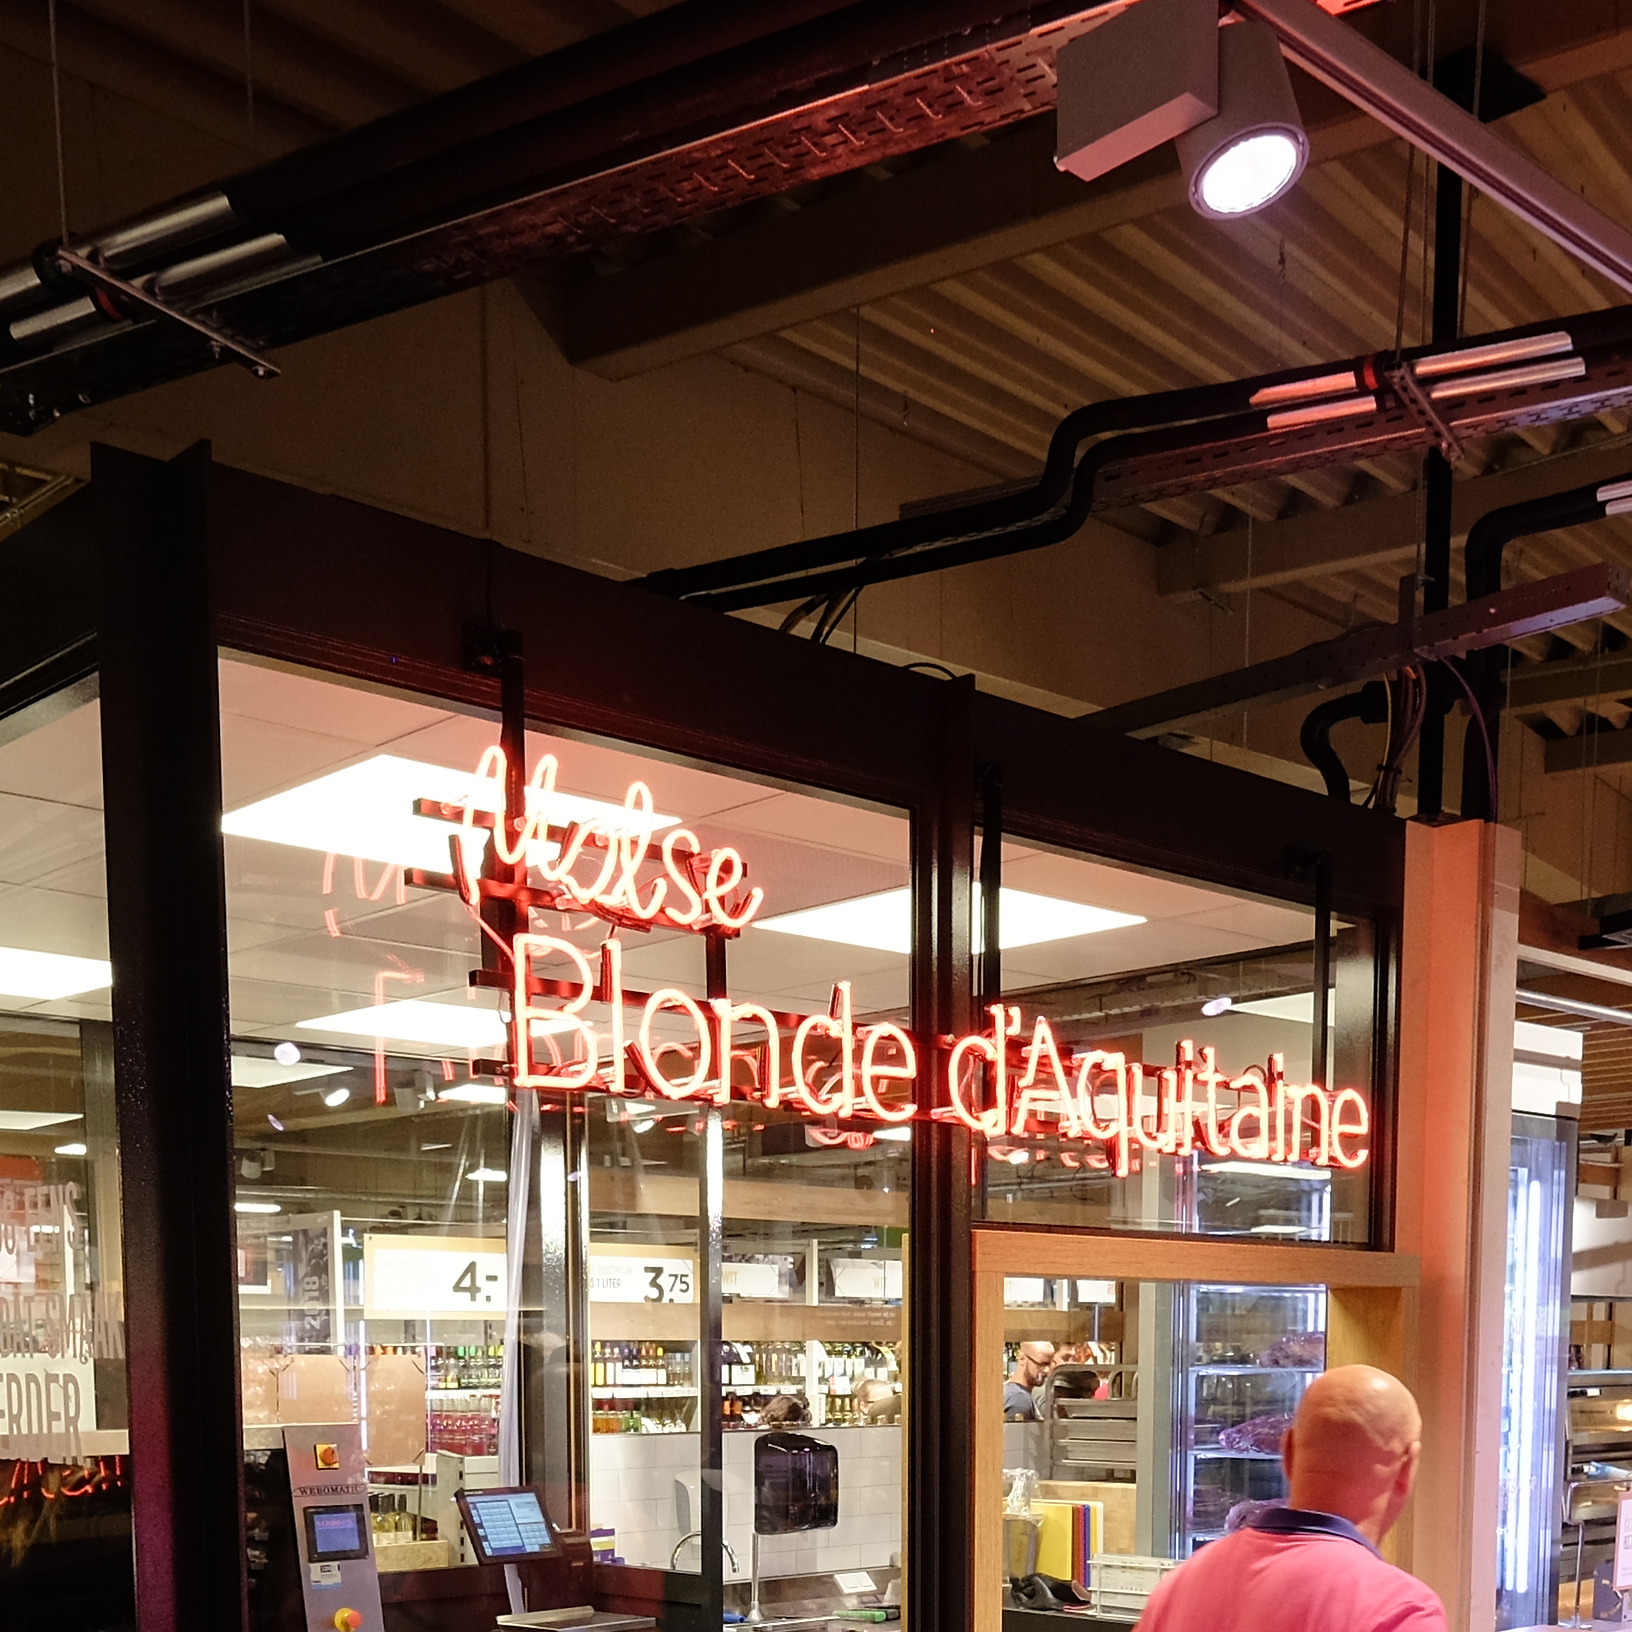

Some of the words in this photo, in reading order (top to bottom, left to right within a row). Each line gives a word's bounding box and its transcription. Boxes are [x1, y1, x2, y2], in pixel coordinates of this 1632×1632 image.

[511, 932, 918, 1124] Blonde
[947, 1002, 1369, 1178] d'Aquitaine
[602, 1278, 622, 1289] LITER
[299, 1485, 360, 1496] WEBOMATIC
